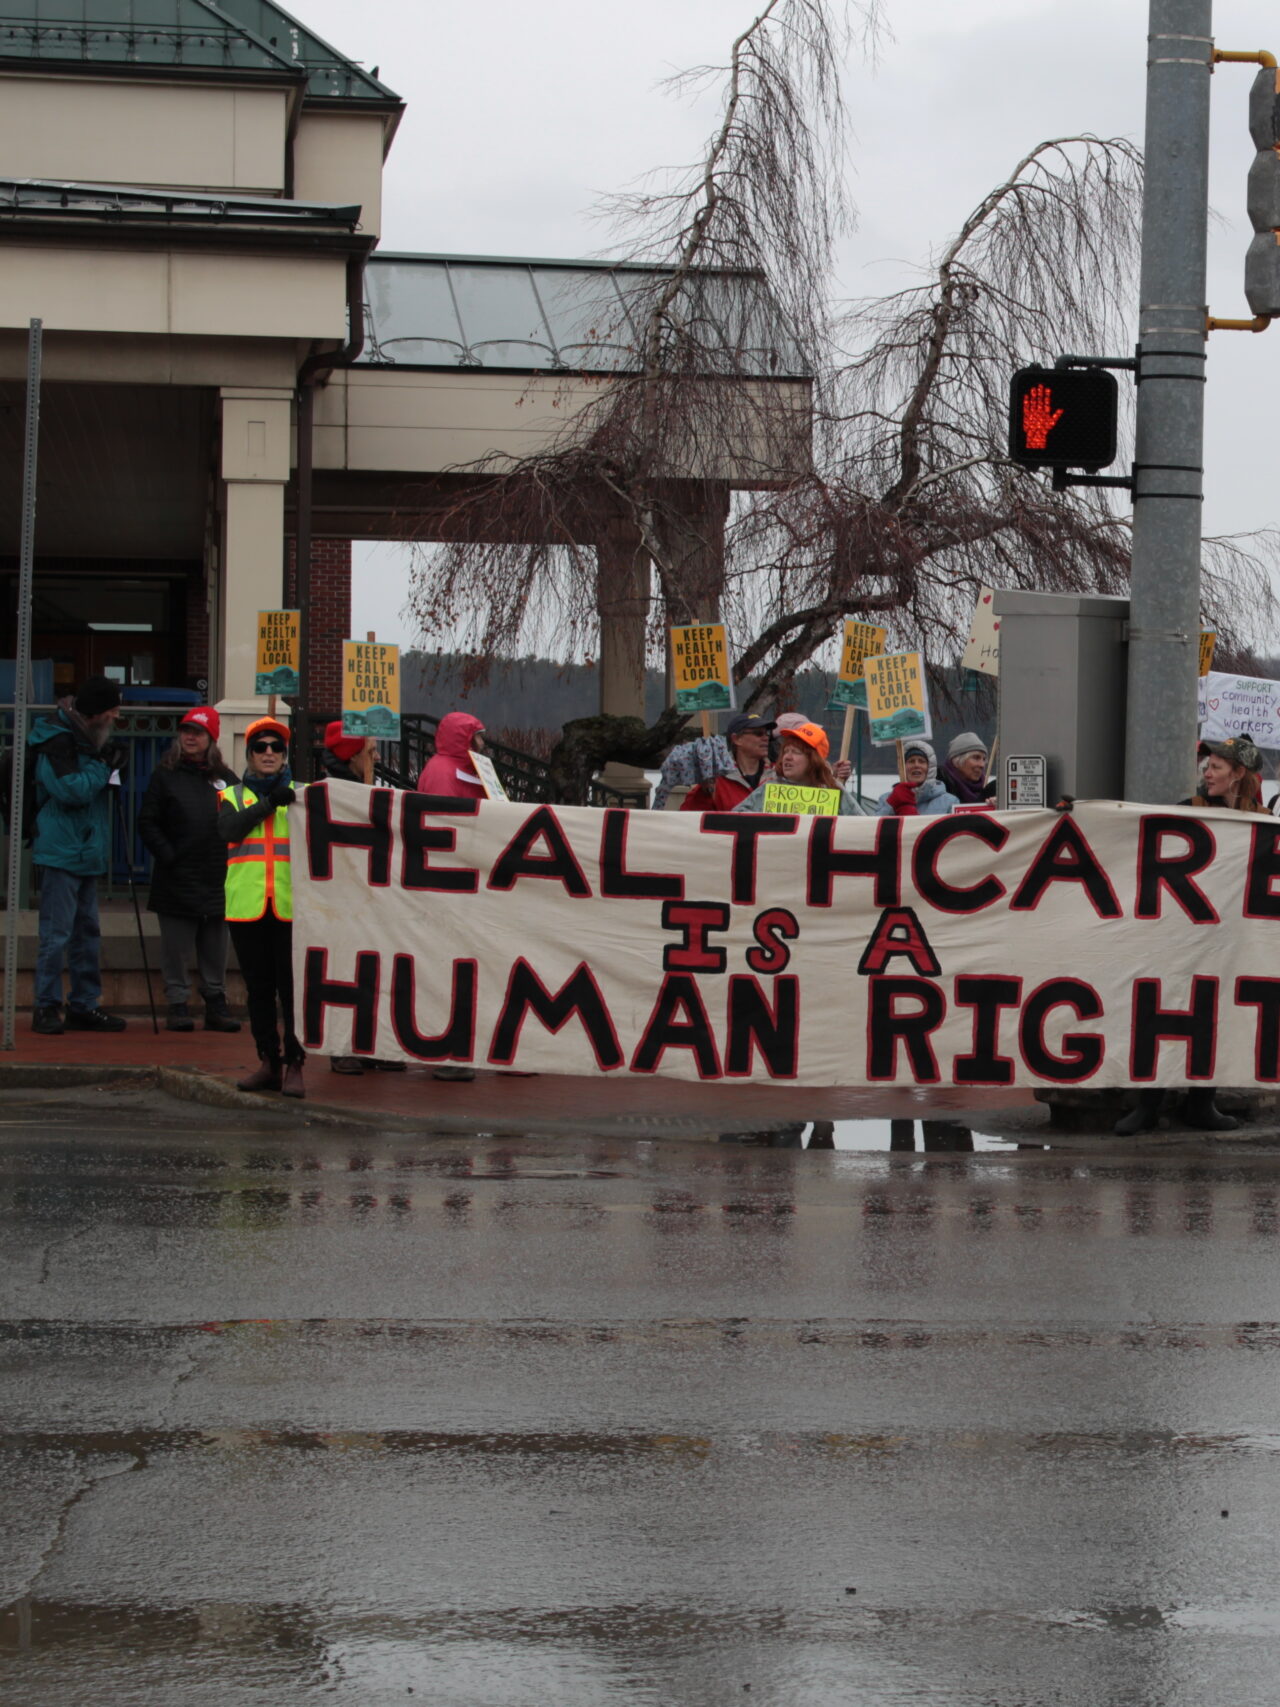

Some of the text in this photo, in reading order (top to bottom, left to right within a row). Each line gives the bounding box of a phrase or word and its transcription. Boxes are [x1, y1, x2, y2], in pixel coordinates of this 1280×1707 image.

[267, 614, 290, 626] KEEP
[260, 626, 296, 639] HEALTH
[683, 628, 712, 641] KEEP
[854, 624, 876, 638] KEEP
[266, 640, 290, 652] CARE
[356, 645, 386, 660] KEEP
[676, 640, 722, 656] HEALTH
[846, 635, 882, 654] HEALTH
[263, 652, 292, 665] LOCAL
[685, 654, 716, 668] CARE
[850, 649, 874, 662] CA
[348, 659, 395, 676] HEALTH
[846, 661, 864, 676] LOC
[877, 656, 907, 672] KEEP
[355, 674, 388, 690] CARE
[683, 667, 720, 681] LOCAL
[870, 668, 916, 686] HEALTH
[879, 681, 910, 697] CARE
[1235, 680, 1274, 694] SUPPORT
[352, 689, 391, 705] LOCAL
[877, 694, 916, 711] LOCAL
[1222, 690, 1278, 708] community
[1231, 704, 1269, 718] health
[1224, 718, 1274, 734] workers
[768, 784, 830, 804] PROUD
[661, 901, 942, 977] IS A
[303, 946, 800, 1080] HUMAN
